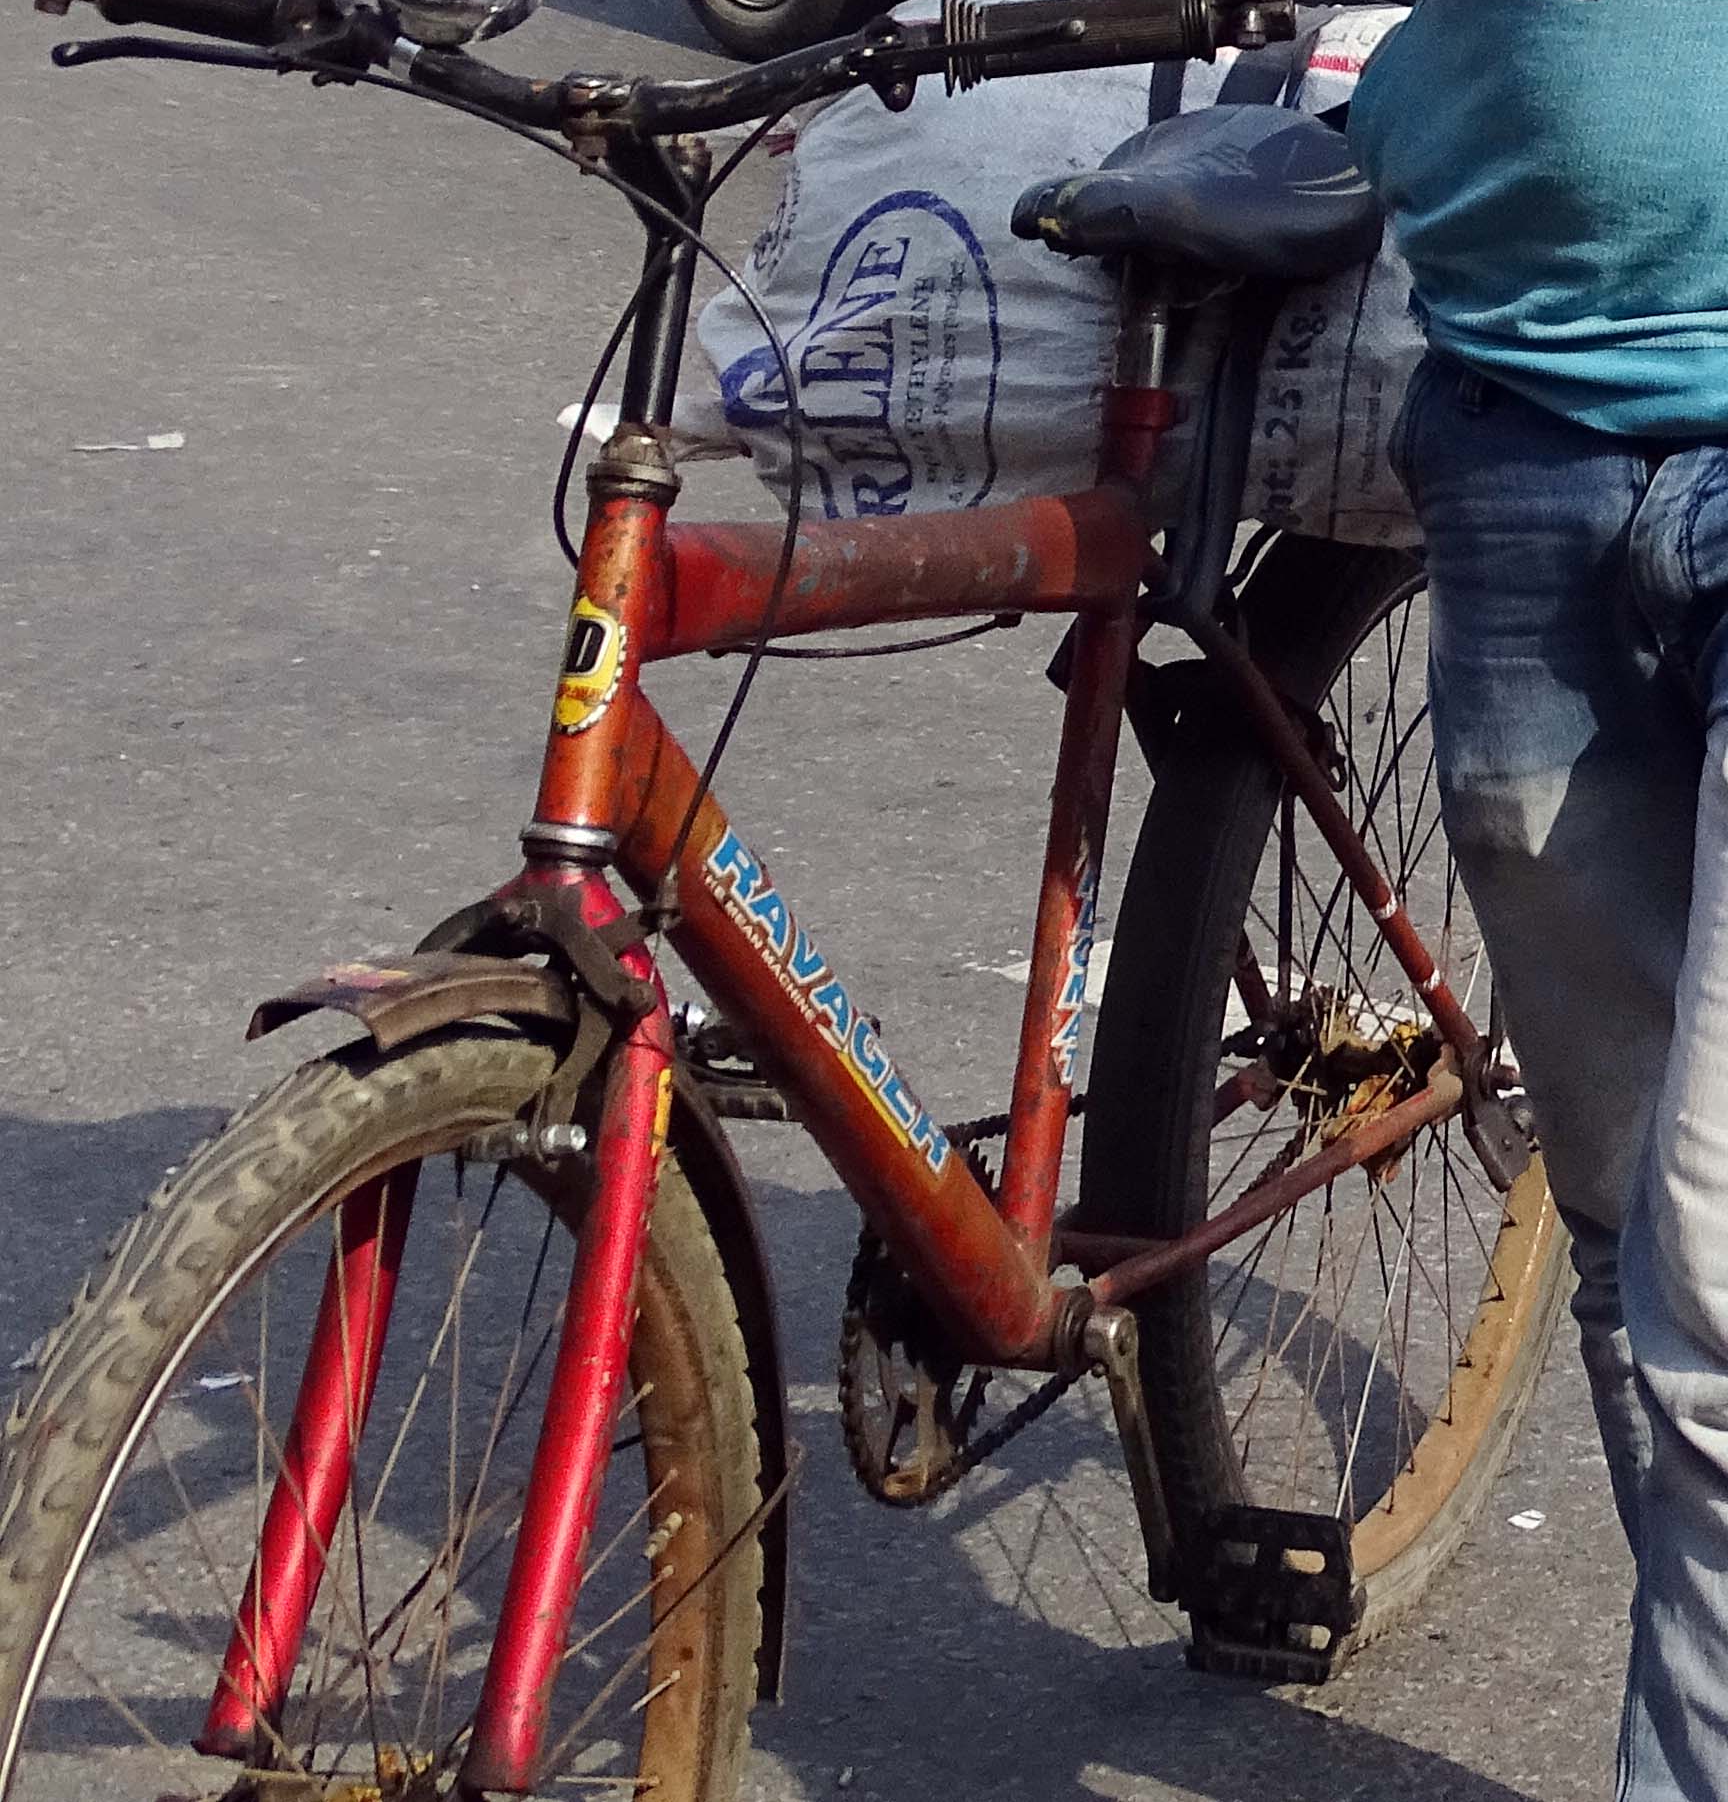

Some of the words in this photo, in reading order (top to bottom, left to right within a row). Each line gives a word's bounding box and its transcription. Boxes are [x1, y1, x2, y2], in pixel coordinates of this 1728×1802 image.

[1275, 302, 1328, 372] Kg.
[1264, 386, 1303, 441] 25
[706, 824, 951, 1175] RAVAGER
[724, 898, 763, 951] MEAN
[760, 948, 817, 1024] MACHINE
